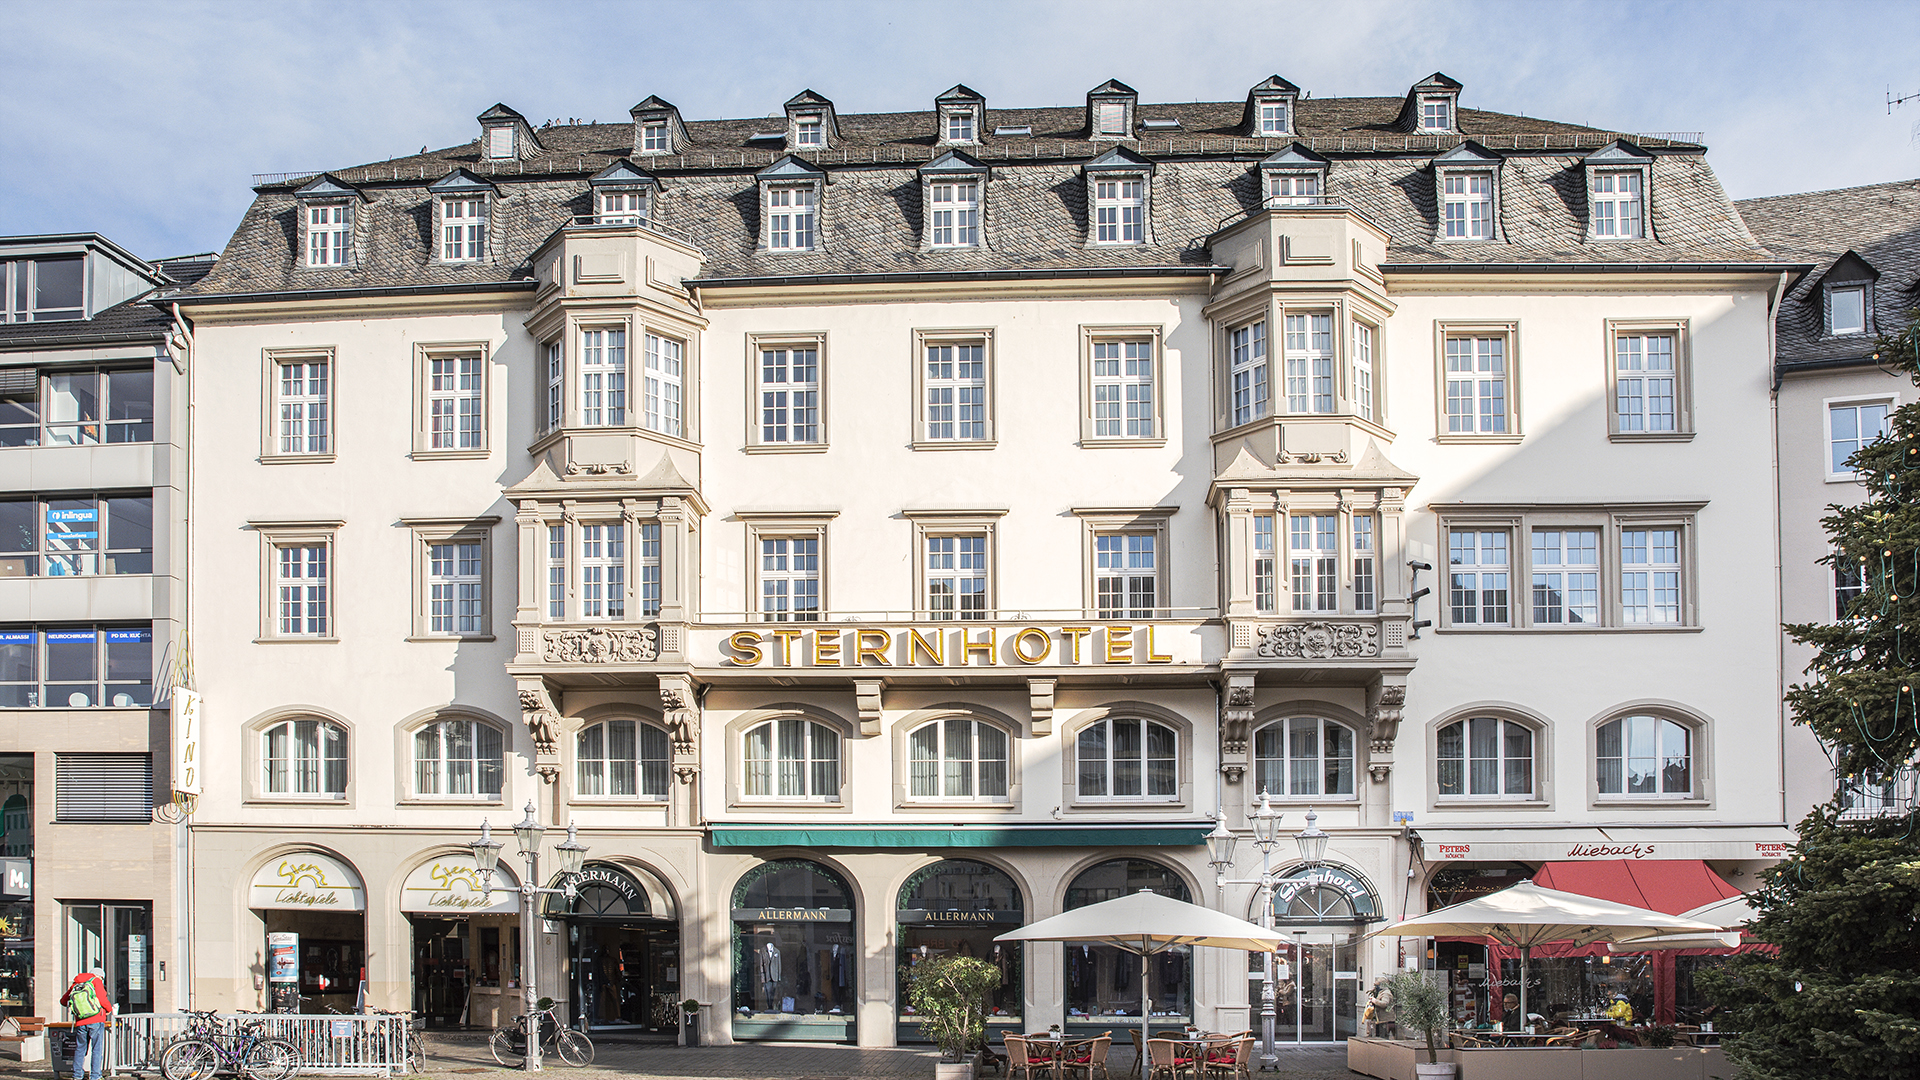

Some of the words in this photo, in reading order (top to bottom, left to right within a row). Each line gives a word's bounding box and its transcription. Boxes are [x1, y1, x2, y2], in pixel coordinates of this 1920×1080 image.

[61, 511, 93, 521] inlingua
[728, 624, 1173, 667] STERNHOTEL
[183, 693, 197, 788] KINO
[1439, 844, 1471, 853] PETERS
[1755, 842, 1787, 851] PETERS
[758, 910, 828, 920] ALLERMANN
[924, 911, 995, 921] ALLERMANN
[1379, 939, 1386, 950] 8
